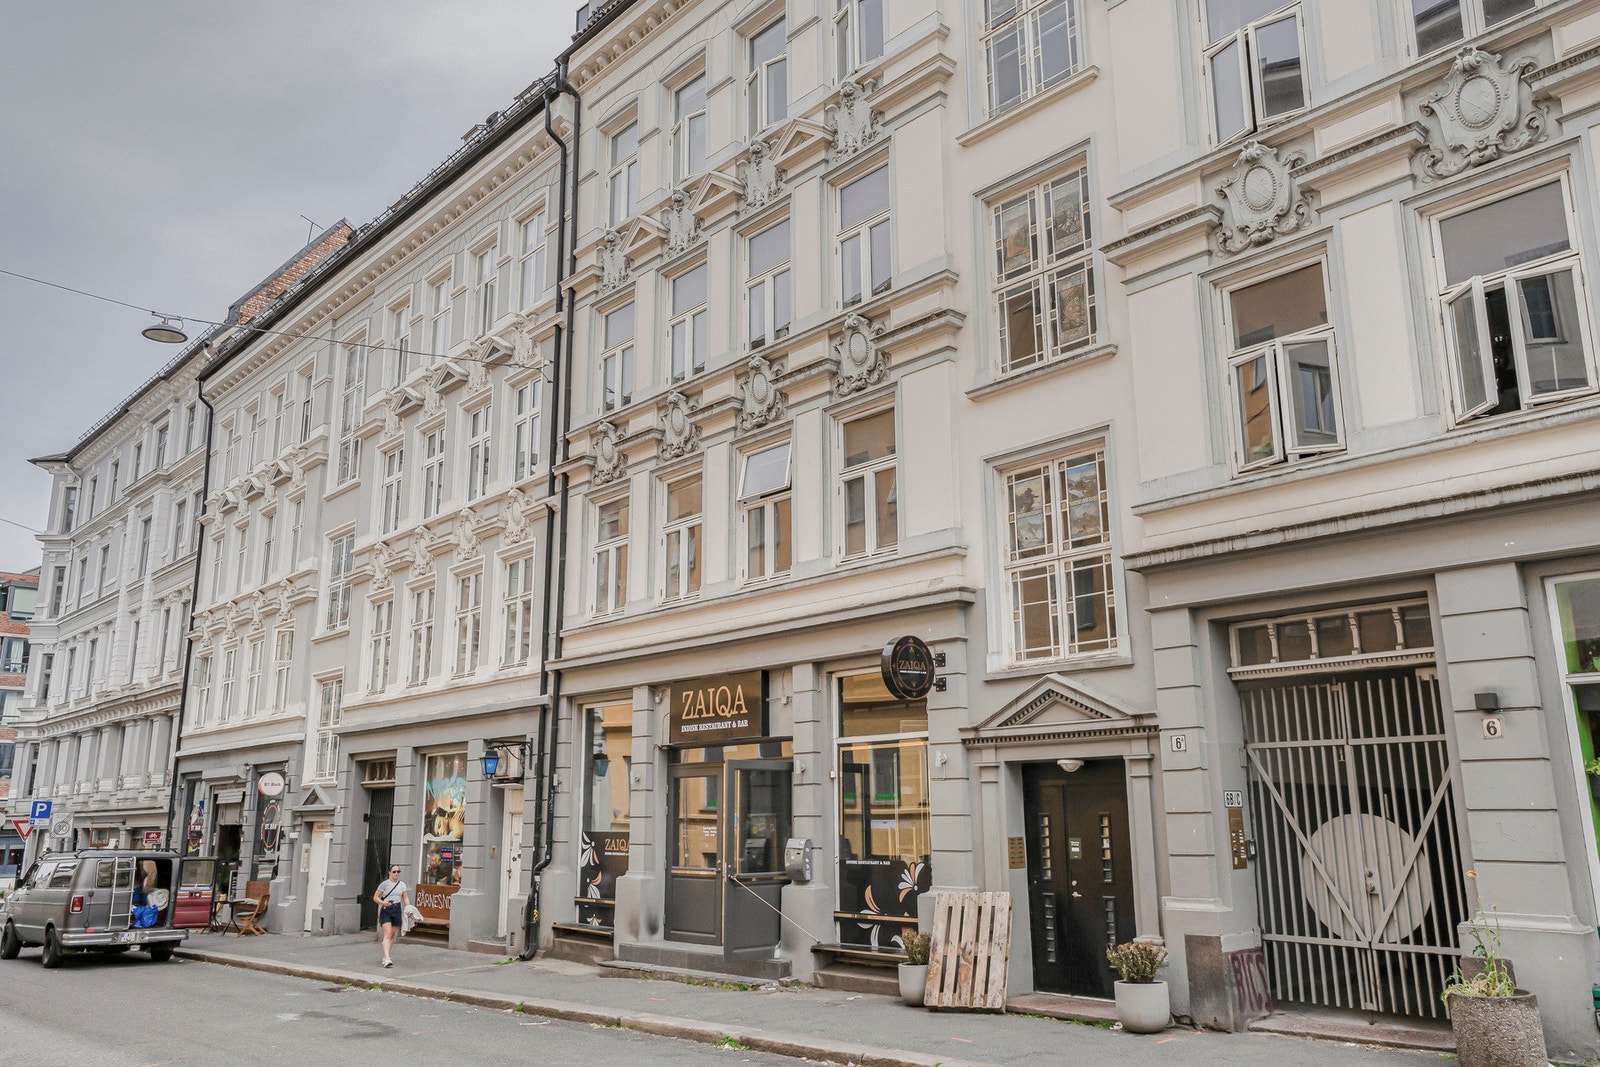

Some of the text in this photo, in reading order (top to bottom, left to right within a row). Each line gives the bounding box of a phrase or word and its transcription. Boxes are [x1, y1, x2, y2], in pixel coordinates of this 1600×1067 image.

[900, 660, 926, 670] ZAIQA
[682, 685, 748, 720] ZAIQA
[681, 719, 749, 732] INDISK RESTAURANT & BAR
[1486, 720, 1498, 736] 6
[35, 802, 48, 817] P
